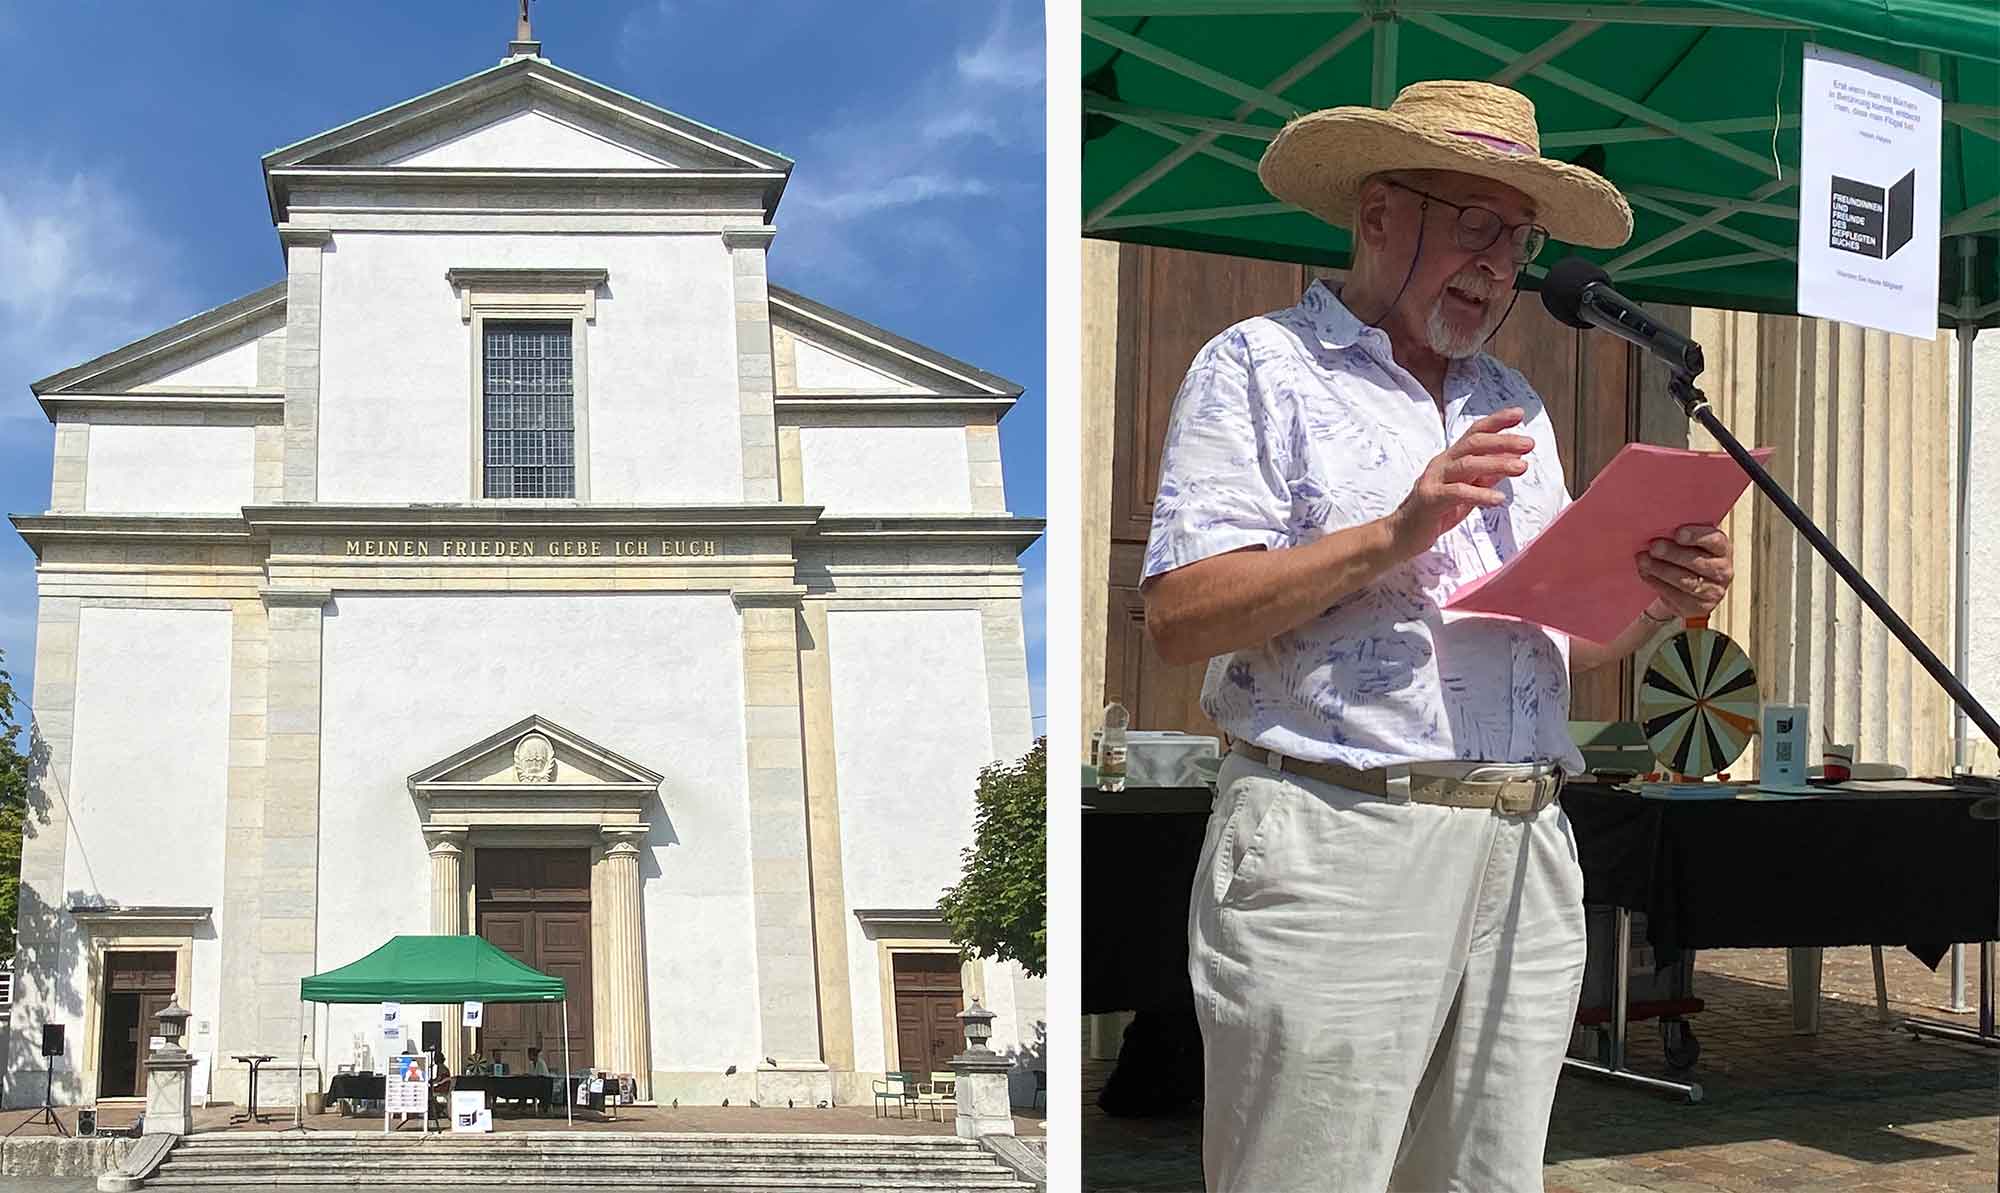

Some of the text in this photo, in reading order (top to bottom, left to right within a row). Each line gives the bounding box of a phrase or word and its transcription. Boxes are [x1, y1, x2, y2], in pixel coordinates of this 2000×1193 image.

[1832, 202, 1849, 213] UND
[1833, 192, 1883, 213] FREUNDINNEN
[1832, 210, 1866, 226] FREUNDE
[1832, 219, 1847, 230] DES
[1831, 228, 1876, 247] GEPFLEGTEN
[1831, 236, 1860, 250] BUCHES
[346, 540, 715, 556] MEINEN FRIEDEN GEBE ICH EUCH
